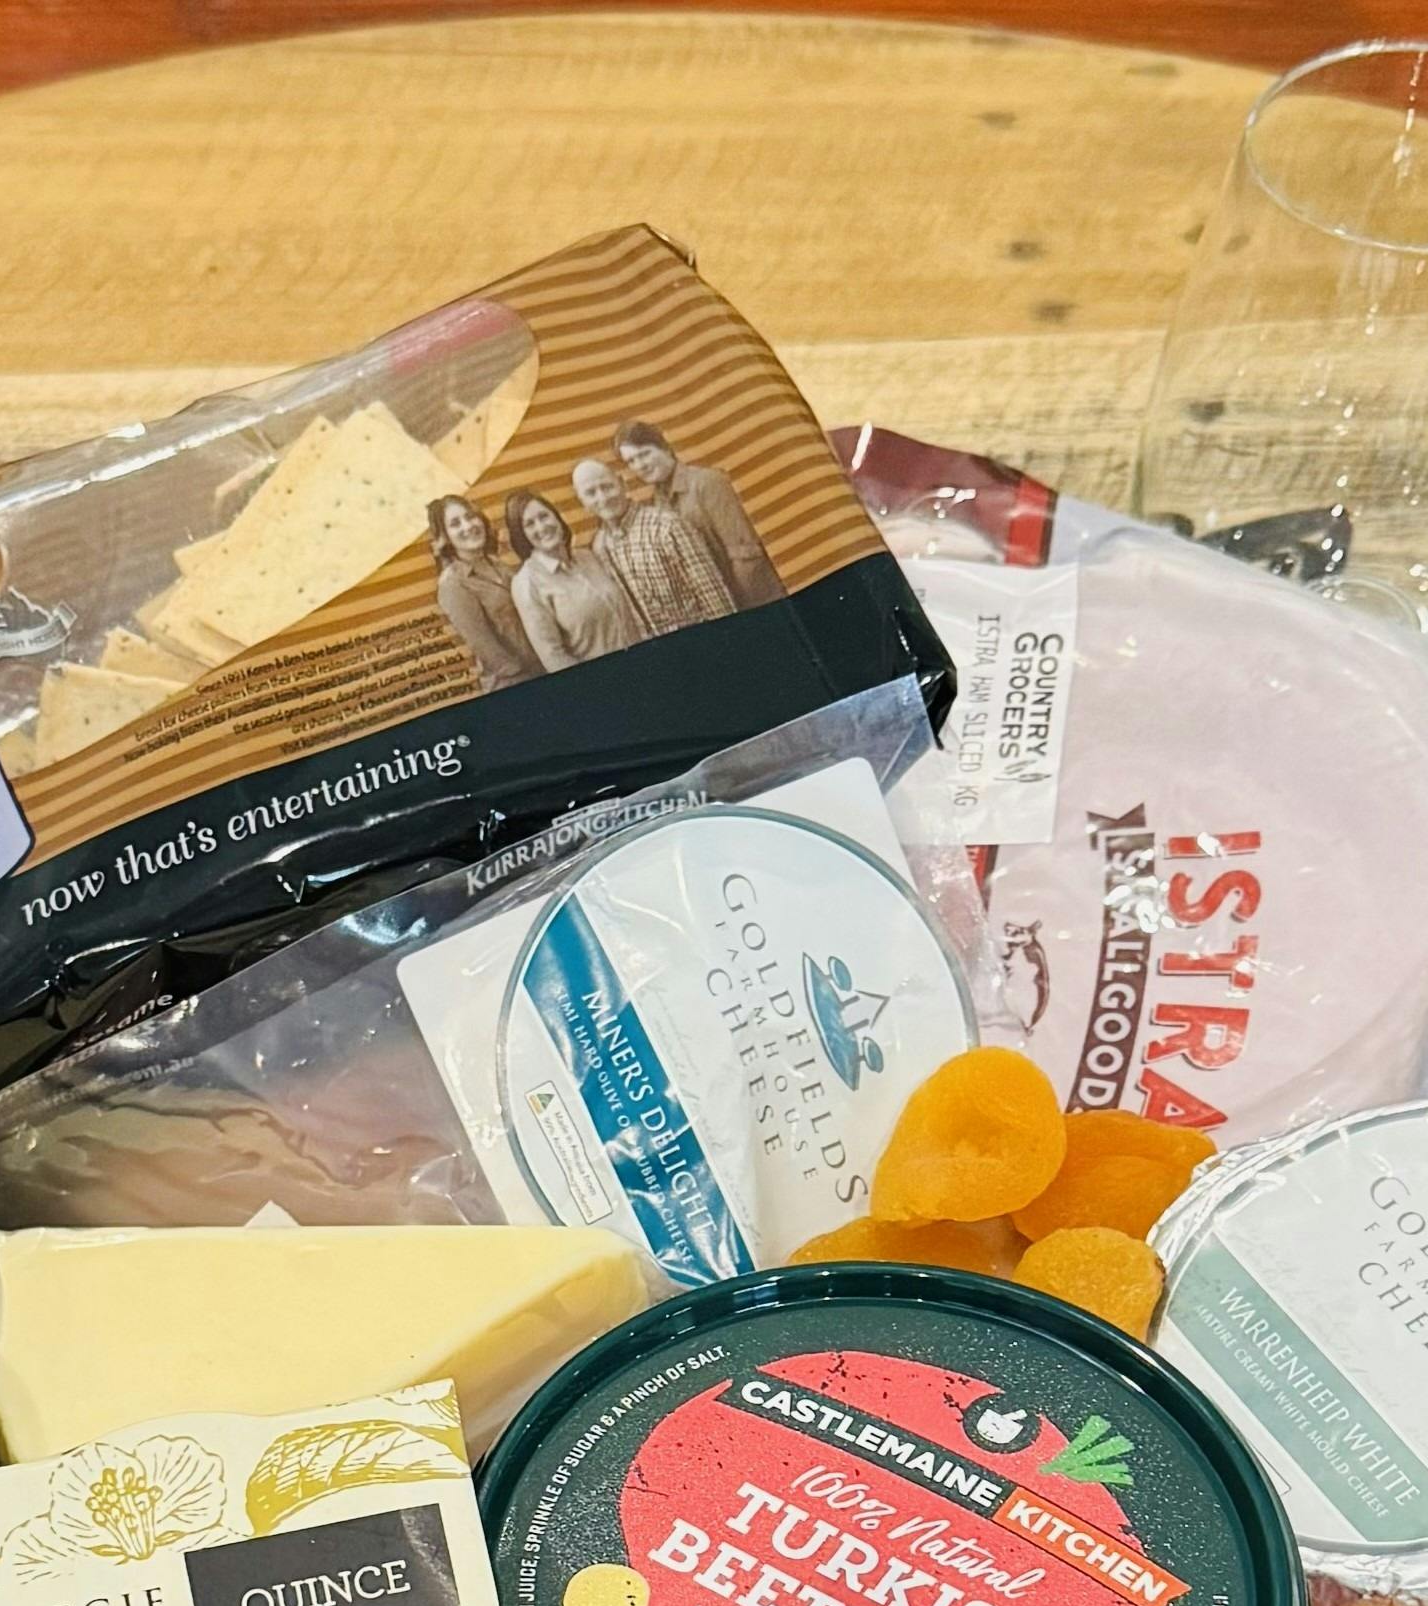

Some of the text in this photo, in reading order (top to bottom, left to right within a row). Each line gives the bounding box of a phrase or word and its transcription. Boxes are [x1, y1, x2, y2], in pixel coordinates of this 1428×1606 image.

[953, 613, 1002, 808] ISTRA HAM SLICED KG
[999, 631, 1039, 760] GROCERS
[1024, 633, 1065, 758] COUNTRY
[20, 871, 106, 927] now
[115, 821, 218, 886] that's
[722, 872, 869, 1205] GOLDFIELDS
[1137, 831, 1262, 1130] ISTRA
[581, 990, 655, 1102] MINER'S
[640, 1105, 718, 1234] DELIGHT
[706, 967, 785, 1157] CHEESE
[714, 920, 820, 1182] FARMHOUSE
[573, 1023, 603, 1071] HARD
[597, 1068, 624, 1112] OLIVE
[659, 1206, 695, 1265] CHEESE
[599, 1413, 617, 1428] &
[611, 1405, 628, 1419] A
[620, 1373, 670, 1411] PINCH
[665, 1361, 689, 1382] OF
[687, 1345, 732, 1371] SALT.
[1194, 1304, 1390, 1518] MATURE CREAMY WHITE MOULD CHEESE
[1219, 1286, 1421, 1507] WARRENHEIP WHITE
[551, 1464, 573, 1486] OF
[563, 1423, 608, 1468] SUGAR
[740, 1379, 1169, 1605] CASTLEMAINE KITCHEN
[517, 1553, 541, 1602] JUICE,
[525, 1484, 564, 1554] SPRINKLE
[790, 1464, 1047, 1600] 100% Natural
